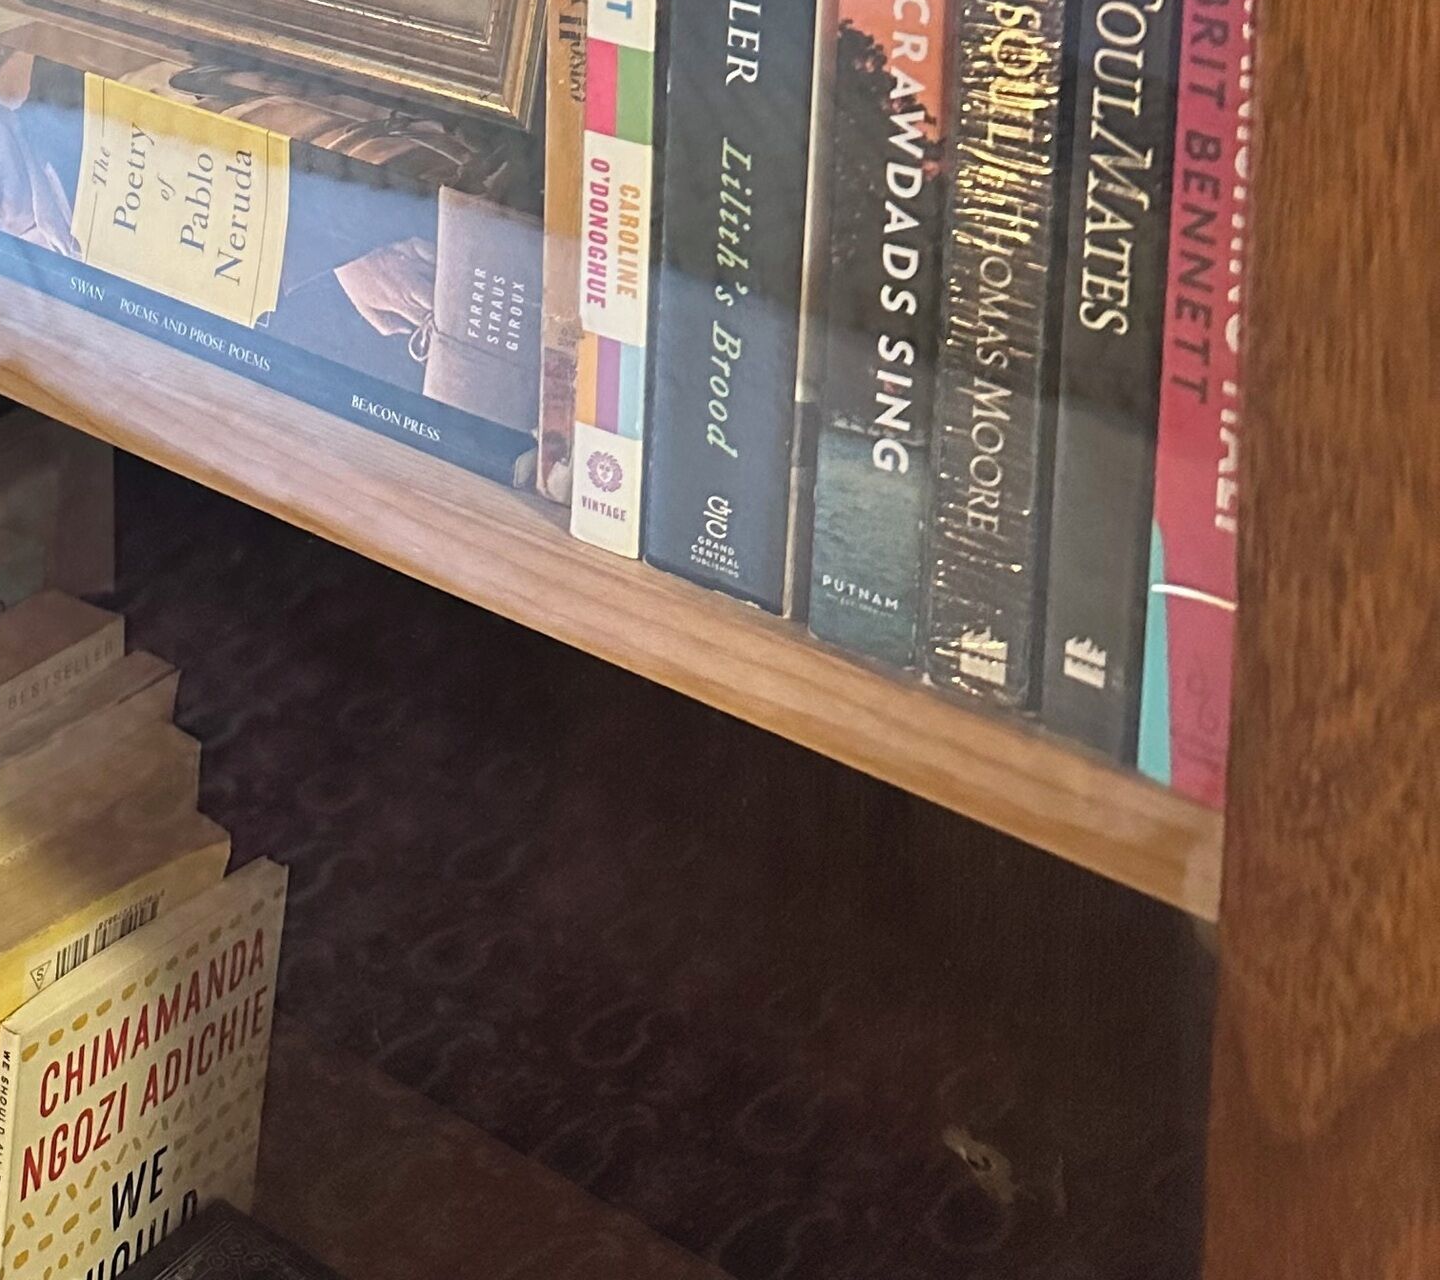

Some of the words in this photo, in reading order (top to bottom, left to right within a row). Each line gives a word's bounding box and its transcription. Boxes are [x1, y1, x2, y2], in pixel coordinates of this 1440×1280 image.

[988, 0, 1043, 148] SOUL
[90, 146, 112, 188] The
[112, 122, 155, 233] Poetry
[156, 173, 176, 202] of
[179, 152, 215, 254] Pablo
[214, 148, 252, 286] Neruda
[585, 157, 611, 309] O'DONOGHUE
[615, 183, 641, 301] CAROLINE
[973, 206, 1026, 371] THOMAS
[1080, 134, 1154, 336] MATES
[1171, 132, 1222, 405] BENNETT
[468, 267, 487, 339] FARRAR
[486, 275, 506, 345] STRAUS
[506, 281, 526, 352] GIROUX
[69, 276, 106, 302] SWAN
[119, 297, 160, 327] POEMS
[161, 314, 188, 337] AND
[189, 325, 226, 356] PROSE
[228, 342, 272, 372] POEMS
[351, 393, 402, 426] BEACON
[403, 415, 442, 442] PRESS
[706, 320, 743, 459] Brood
[872, 335, 916, 475] SING
[581, 494, 628, 523] VINTAGE
[967, 378, 1011, 534] MOORE
[691, 544, 739, 569] CENTRAL
[691, 554, 739, 579] PUBLISHING
[698, 535, 735, 556] GRAND
[822, 574, 899, 611] PUTNAM
[2, 1049, 12, 1072] WE
[39, 927, 265, 1118] CHIMAMANDA
[19, 1081, 129, 1203] NGOZI
[140, 986, 268, 1117] ADICHIE
[111, 1145, 169, 1233] WE
